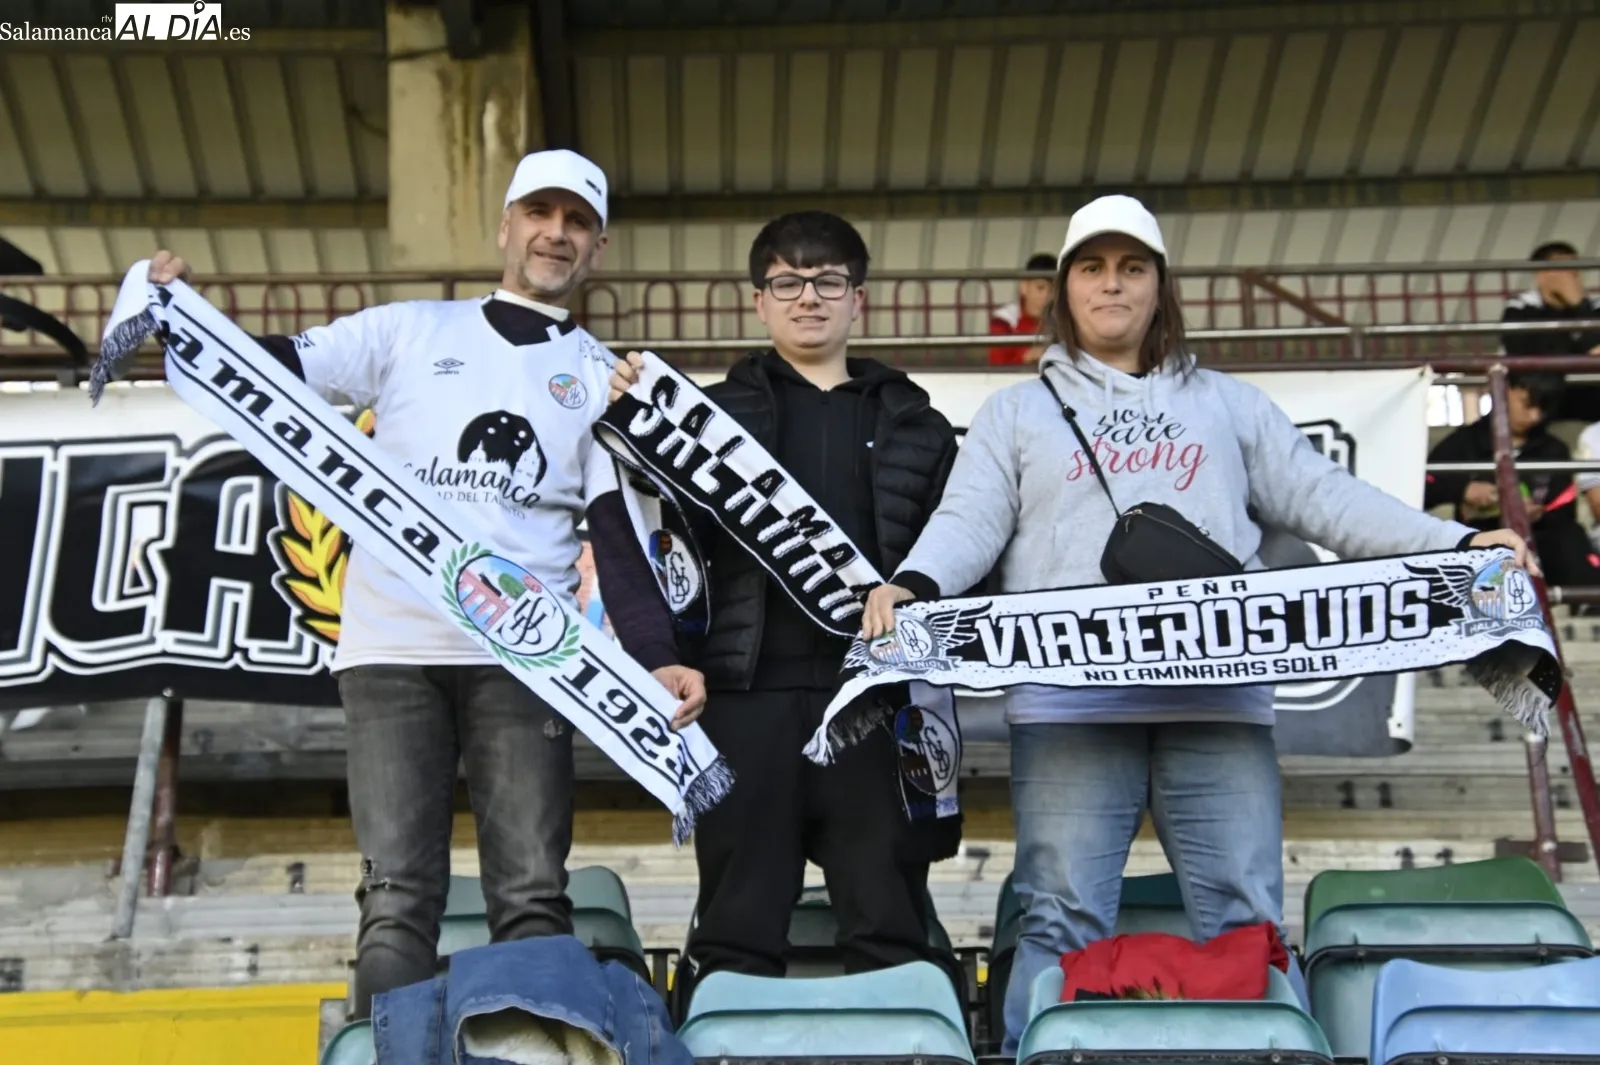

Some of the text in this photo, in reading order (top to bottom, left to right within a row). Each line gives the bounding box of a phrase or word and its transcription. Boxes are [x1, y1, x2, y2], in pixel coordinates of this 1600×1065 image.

[160, 287, 440, 563] amanca
[1093, 409, 1173, 437] you
[1111, 421, 1187, 446] are
[1067, 436, 1208, 491] strong
[404, 456, 541, 509] alamanca
[457, 491, 478, 502] DEL
[1148, 580, 1248, 600] PEÑA
[975, 594, 1289, 668] VIAJEROS
[1301, 579, 1432, 650] UDS
[1084, 670, 1118, 682] NO
[1272, 655, 1338, 674] SOLA
